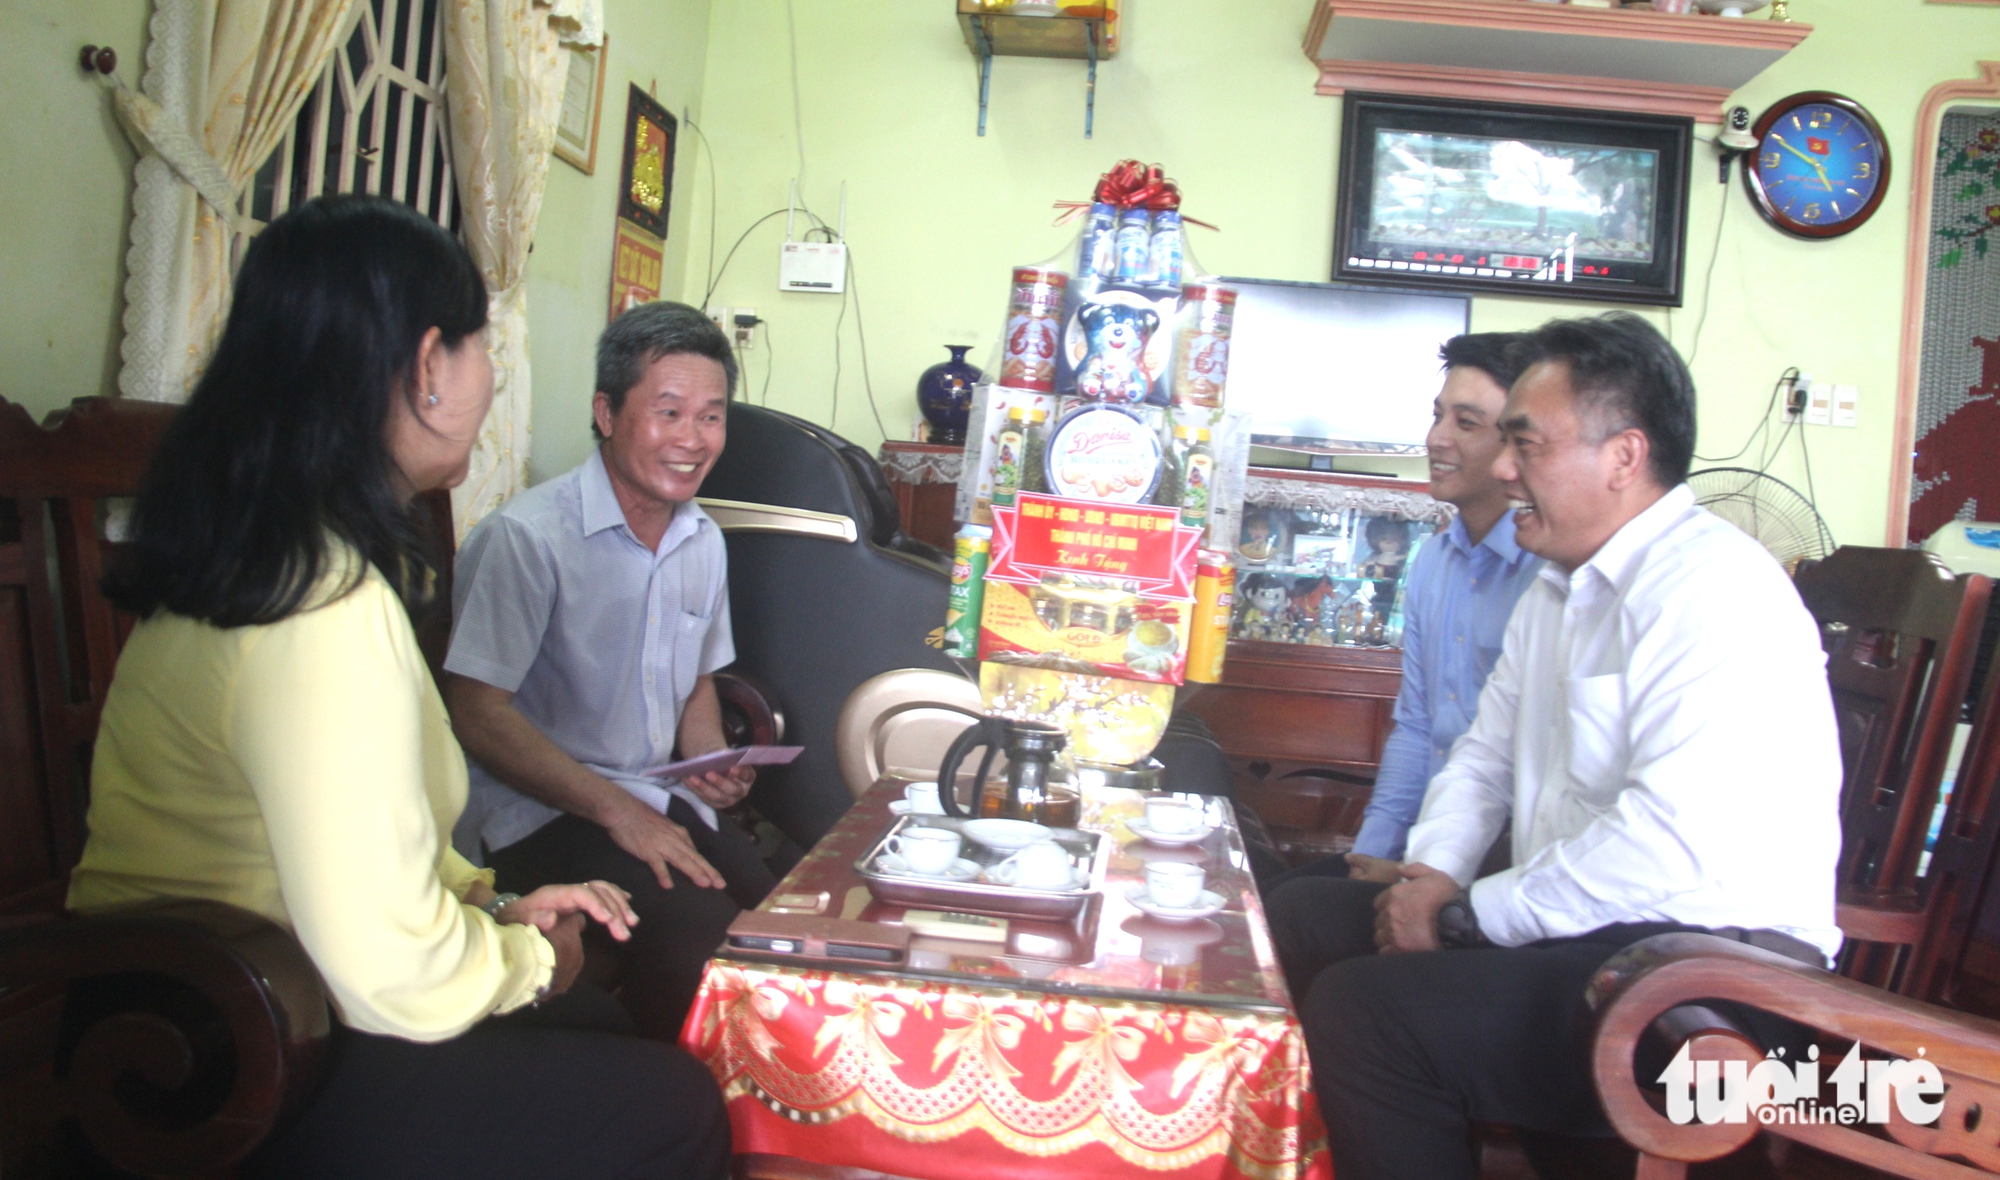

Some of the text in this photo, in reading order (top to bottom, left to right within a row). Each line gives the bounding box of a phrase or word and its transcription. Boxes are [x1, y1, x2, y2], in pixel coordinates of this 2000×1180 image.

[1809, 111, 1832, 129] 12
[1764, 152, 1781, 169] 9
[1852, 162, 1871, 179] 3
[1803, 202, 1820, 219] 6
